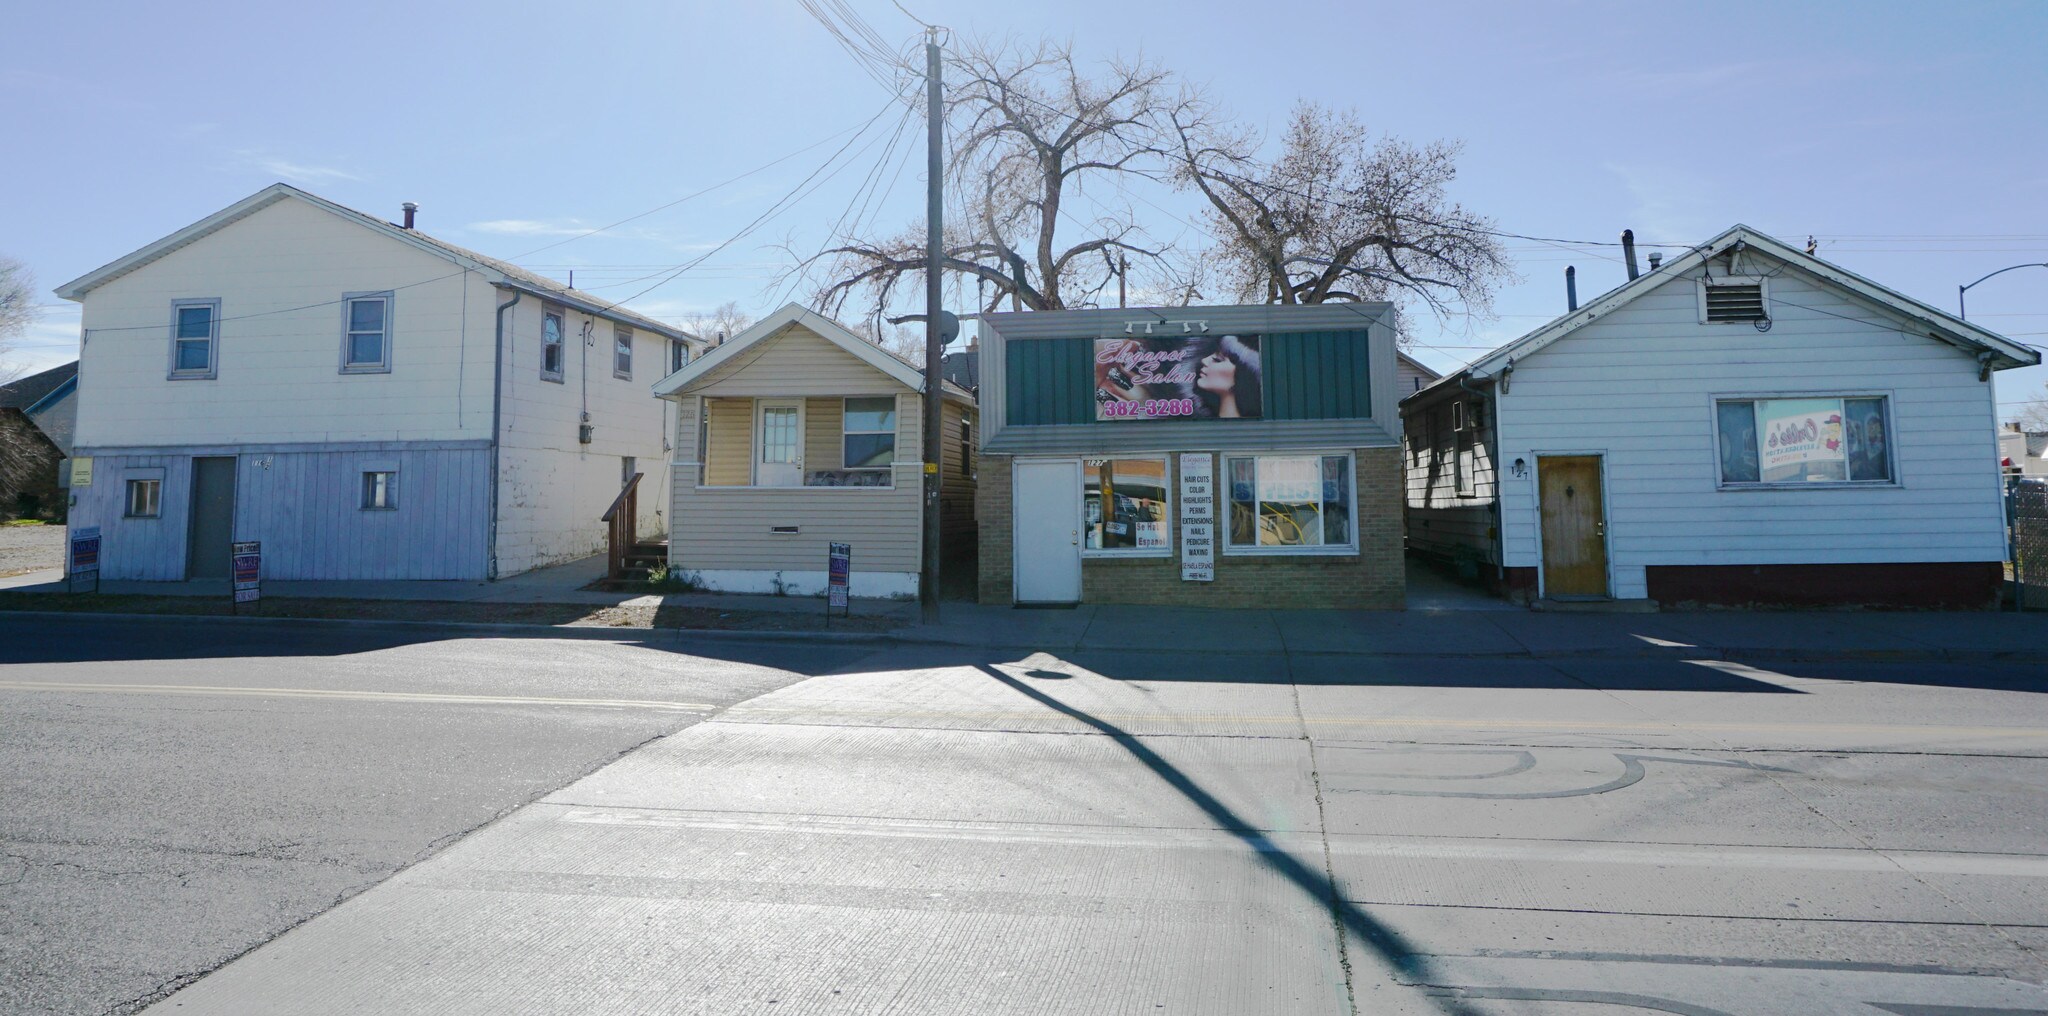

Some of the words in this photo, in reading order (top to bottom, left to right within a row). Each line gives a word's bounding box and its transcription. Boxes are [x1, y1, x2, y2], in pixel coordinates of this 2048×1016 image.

[1096, 341, 1188, 371] Elegance
[1131, 361, 1197, 385] Salon
[1104, 399, 1193, 417] 382-3288
[1511, 466, 1528, 480] 127
[1184, 475, 1196, 483] HAIR
[1197, 475, 1210, 483] CUTS
[1189, 486, 1205, 494] COLOR
[1183, 496, 1211, 504] HIGHLIGHTS
[1189, 507, 1206, 515] PERMS
[1182, 517, 1213, 525] EXTENSIONS
[1136, 523, 1145, 531] Se
[1190, 528, 1206, 536] NAILS
[1186, 538, 1210, 546] PEDICURE
[1188, 549, 1208, 557] WAXING
